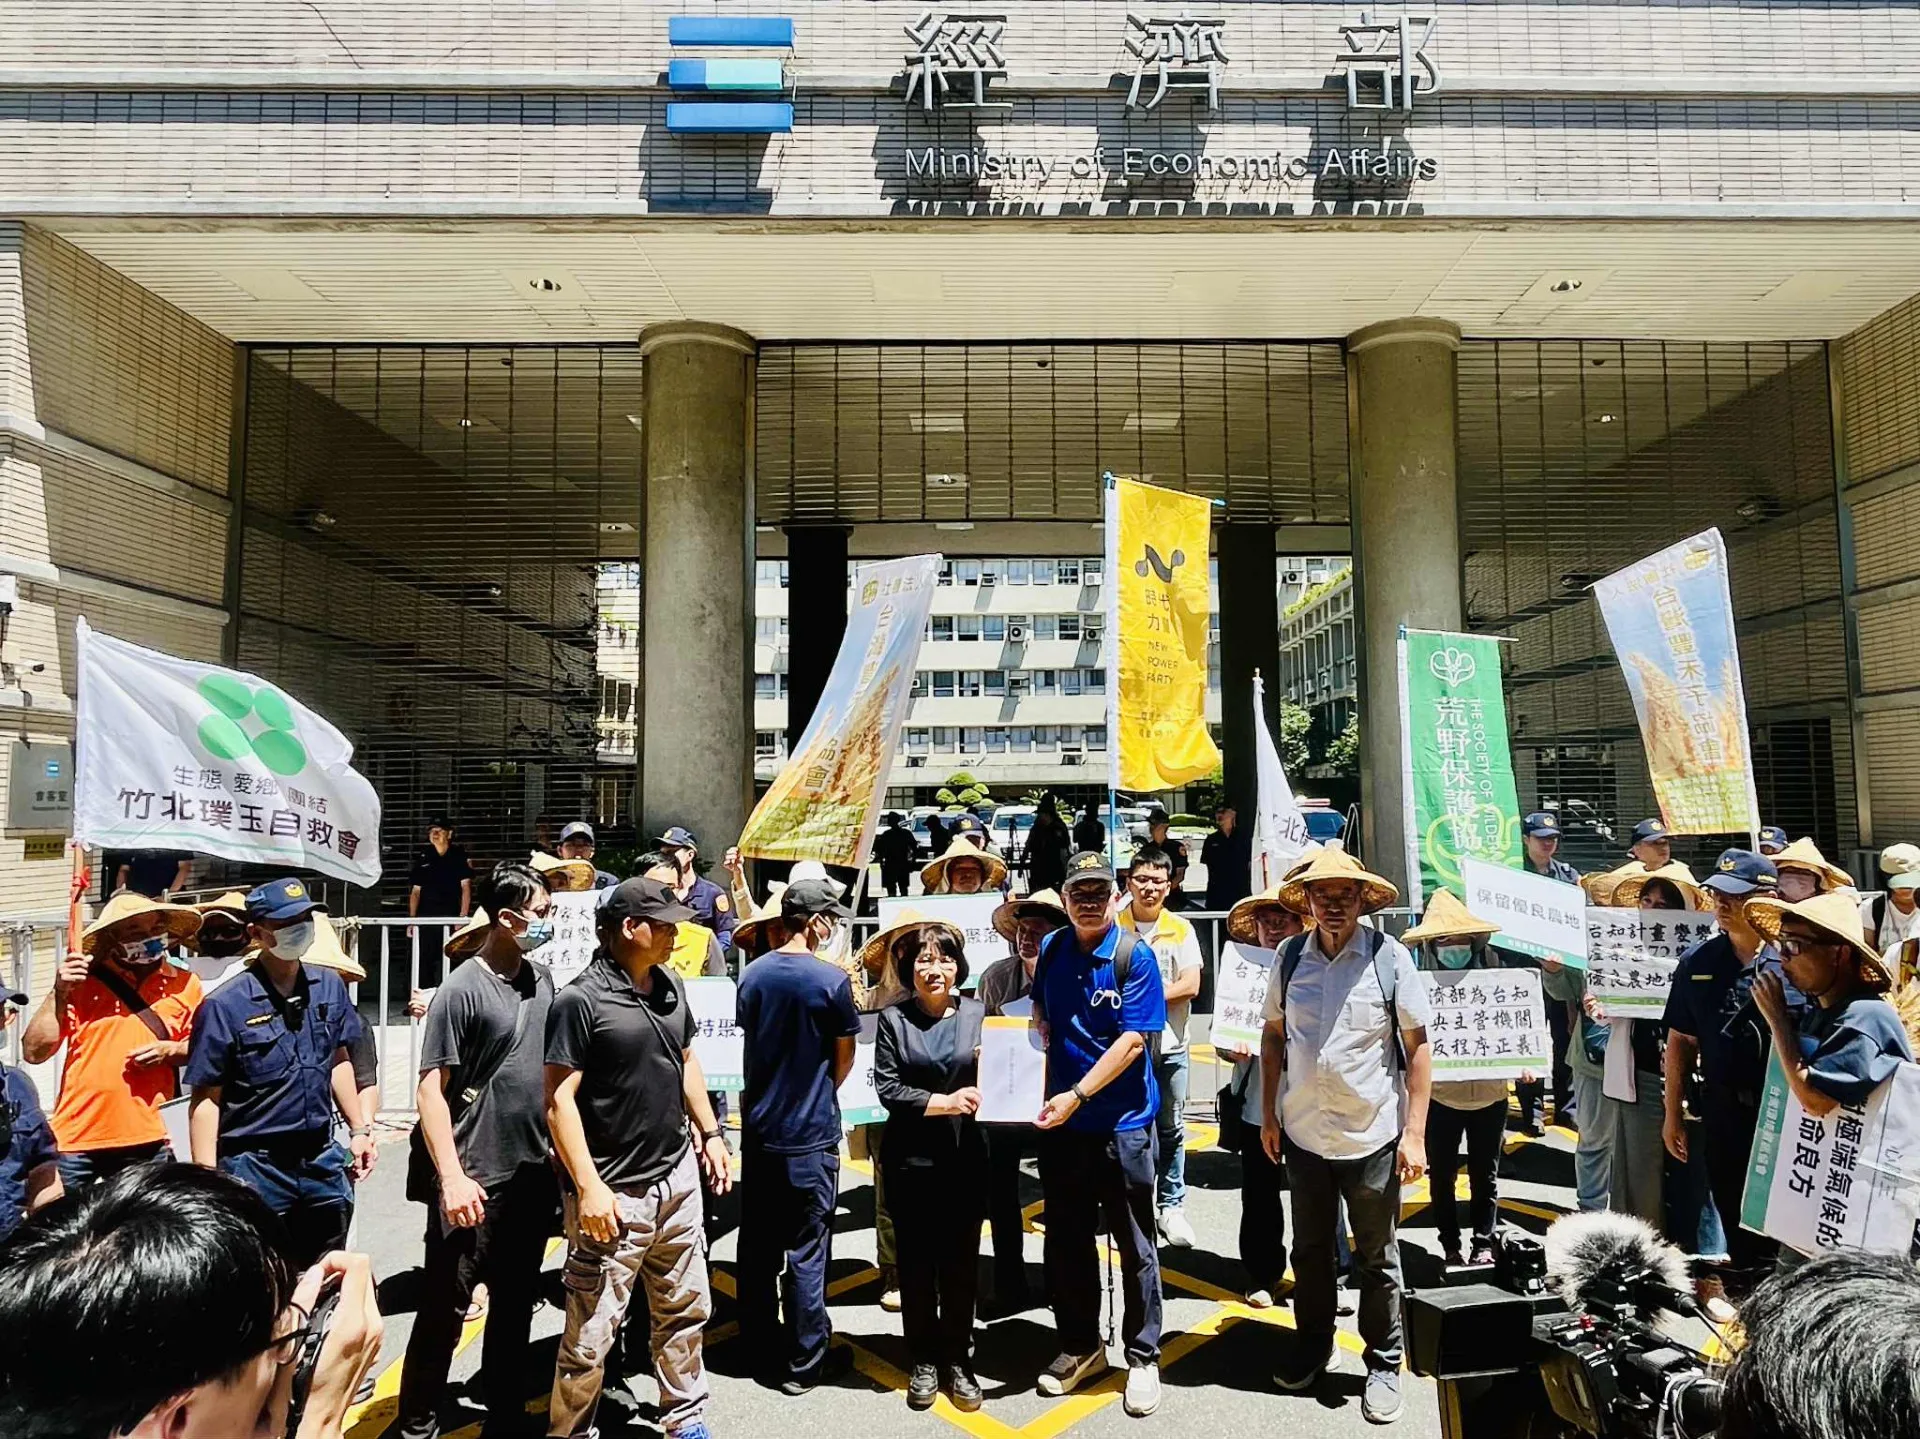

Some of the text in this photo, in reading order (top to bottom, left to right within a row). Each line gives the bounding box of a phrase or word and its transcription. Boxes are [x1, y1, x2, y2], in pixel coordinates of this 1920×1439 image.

[903, 8, 1439, 113] 經濟部
[905, 147, 1438, 181] Ministry of Economic Affairs
[1147, 656, 1179, 670] POWER
[1148, 641, 1169, 652] NEW
[1146, 672, 1175, 685] PARTY
[1472, 723, 1491, 775] SOCIETY
[173, 765, 222, 790] 生態
[287, 787, 329, 815] 團結
[1480, 780, 1494, 798] OF
[118, 786, 361, 860] 竹北璞玉自救會
[694, 1018, 745, 1039] 持聚
[1789, 1108, 1826, 1199] 命良方
